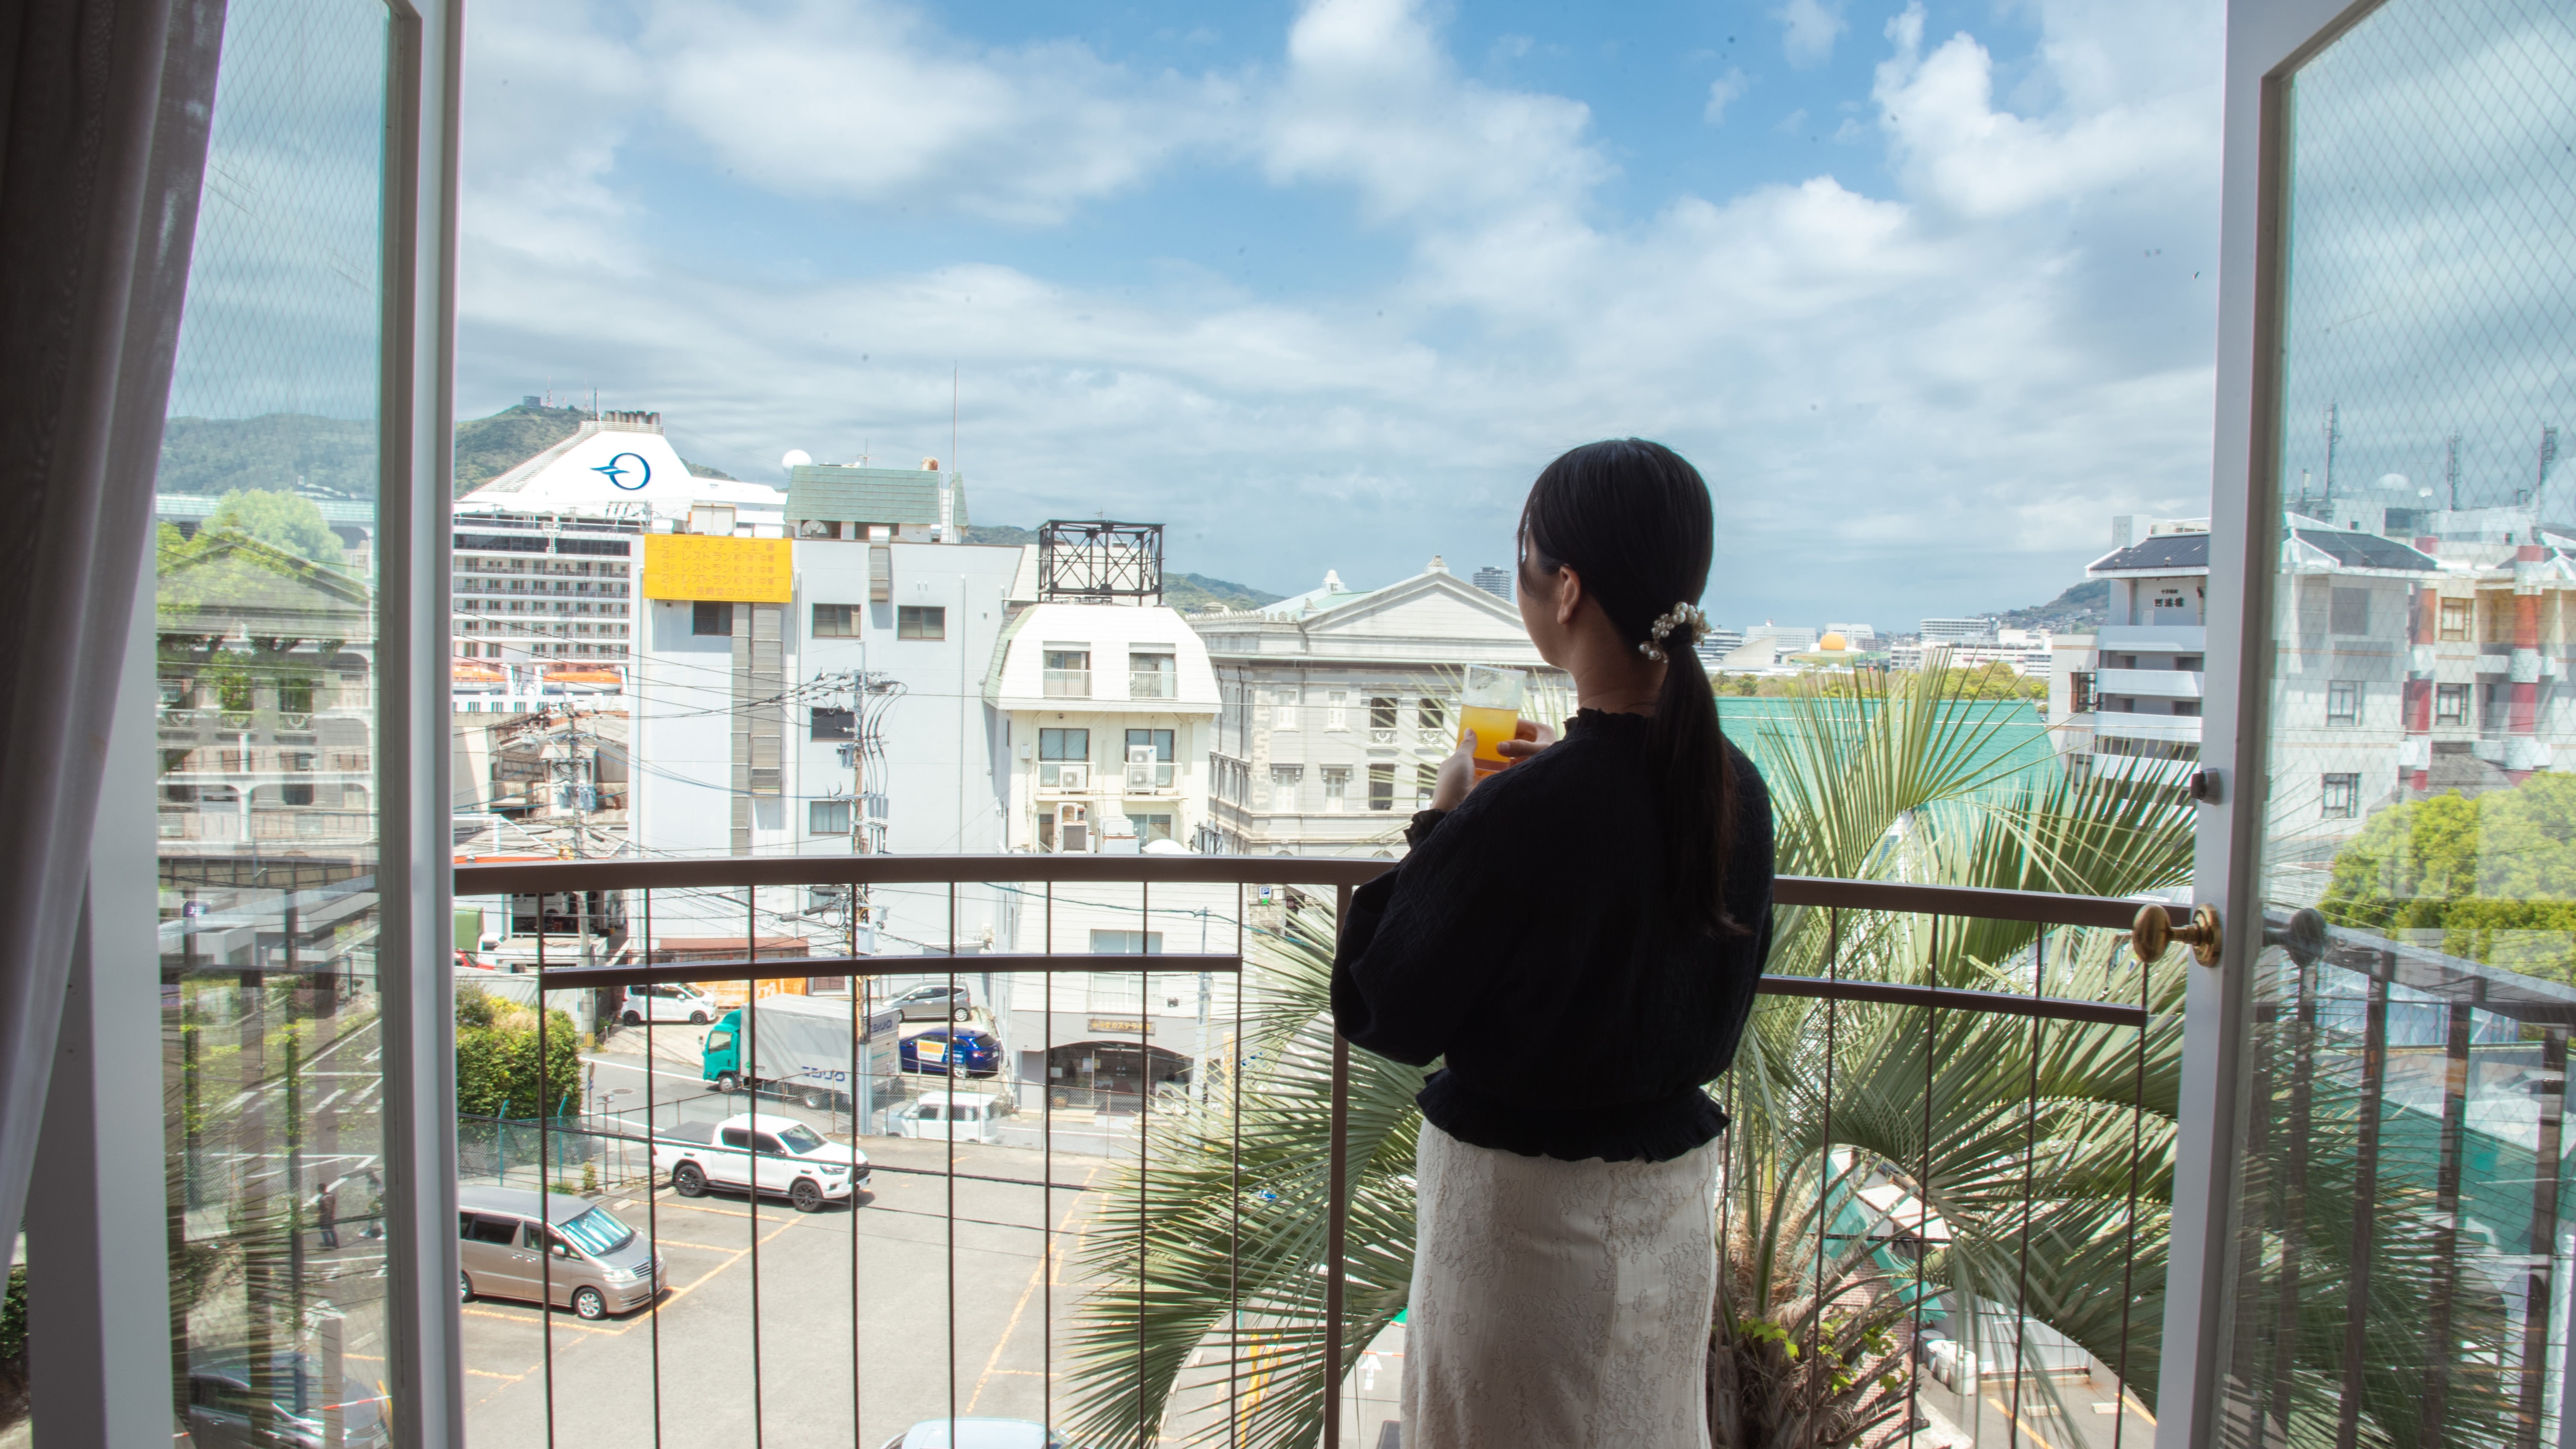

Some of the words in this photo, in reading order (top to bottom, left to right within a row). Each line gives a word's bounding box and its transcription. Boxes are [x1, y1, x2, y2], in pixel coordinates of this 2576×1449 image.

[662, 539, 676, 549] 5F
[662, 550, 677, 560] 4F
[662, 562, 676, 572] 3F
[662, 574, 676, 584] 2F
[663, 586, 676, 594] 1F
